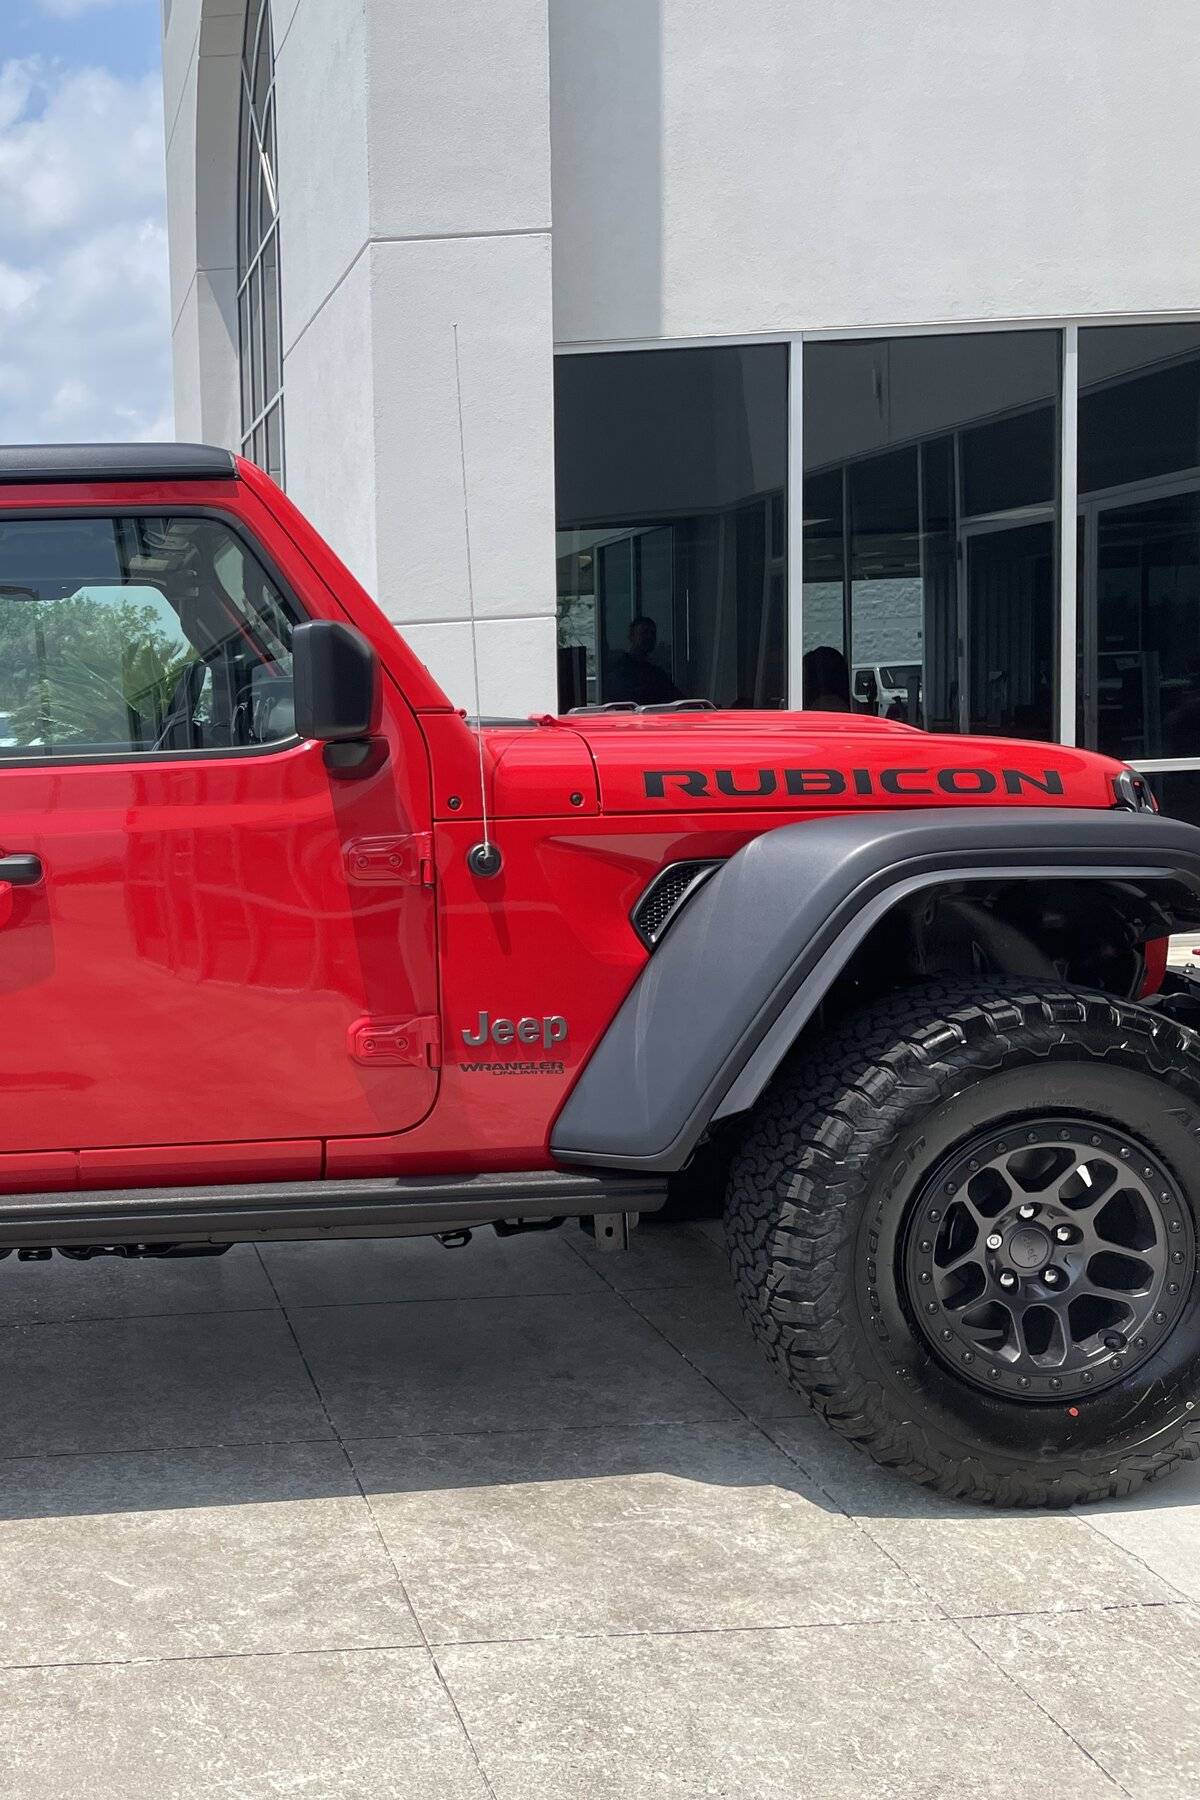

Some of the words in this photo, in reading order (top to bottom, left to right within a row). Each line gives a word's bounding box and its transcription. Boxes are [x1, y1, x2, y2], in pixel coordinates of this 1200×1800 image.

[642, 769, 1065, 798] RUBICON
[461, 1010, 569, 1049] Jeep
[459, 1061, 564, 1072] WRANGLER
